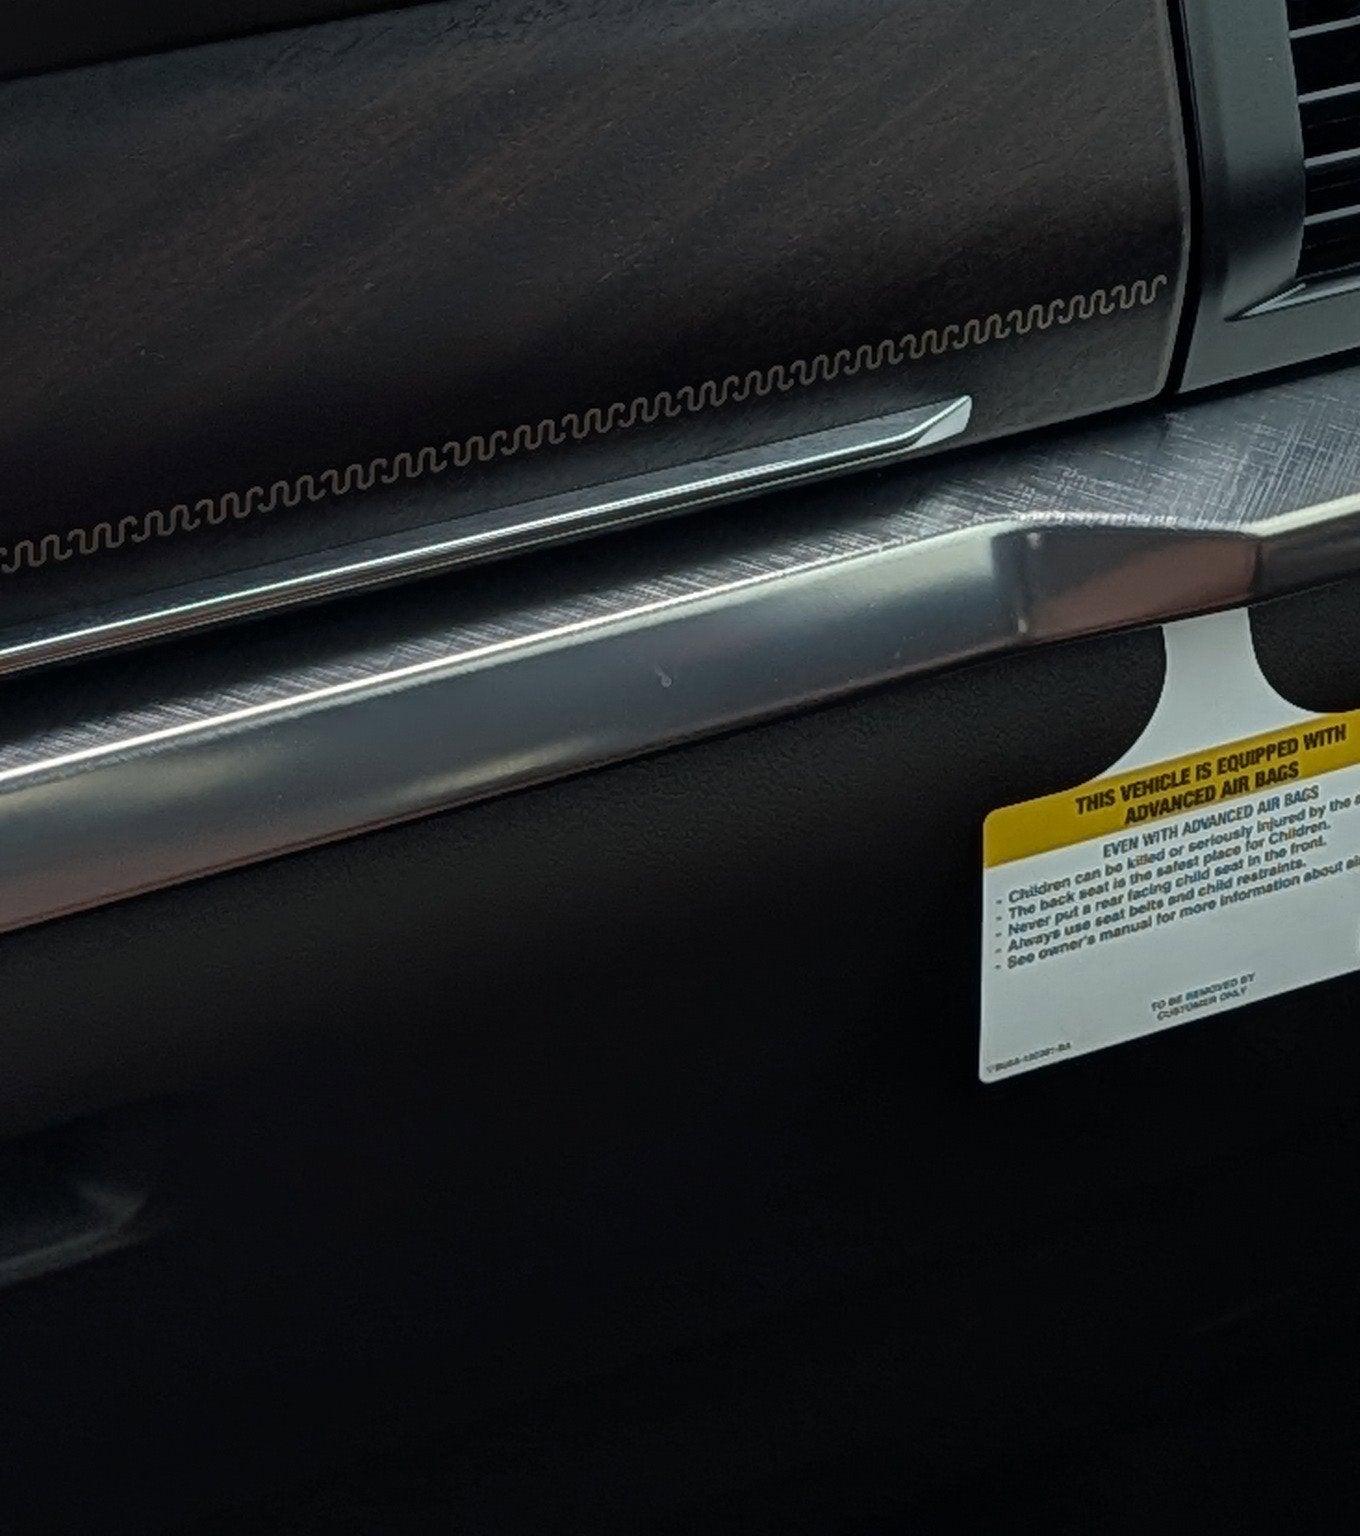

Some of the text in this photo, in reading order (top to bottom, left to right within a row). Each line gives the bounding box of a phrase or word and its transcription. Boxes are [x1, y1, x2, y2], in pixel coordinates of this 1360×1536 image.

[1074, 723, 1347, 815] THIS VEHICLE IS EQUIPPED WITH
[1123, 760, 1299, 826] ADVANCED AIR BAGS
[1008, 876, 1071, 904] Children
[1074, 868, 1101, 885] can
[1104, 862, 1123, 877] be
[1126, 847, 1165, 870] killed
[1167, 844, 1185, 858] or
[1187, 824, 1253, 853] seriously
[1256, 807, 1305, 834] injured
[1308, 804, 1327, 819] by
[1328, 797, 1352, 812] the
[1008, 819, 1331, 920] The back seat is the safest place for Children.
[1102, 784, 1319, 858] EVEN WITH ADVANCED AIR BAGS
[1006, 952, 1036, 969] See
[1037, 934, 1096, 960] owner's
[1098, 914, 1152, 942] manual
[1155, 910, 1176, 926] for
[1178, 899, 1217, 919] more
[1219, 874, 1301, 907] information
[1303, 860, 1343, 883] about
[1007, 834, 1327, 937] Never put a rear facing child seat in the front.
[1007, 858, 1307, 953] Always use seat belts and child restraints.
